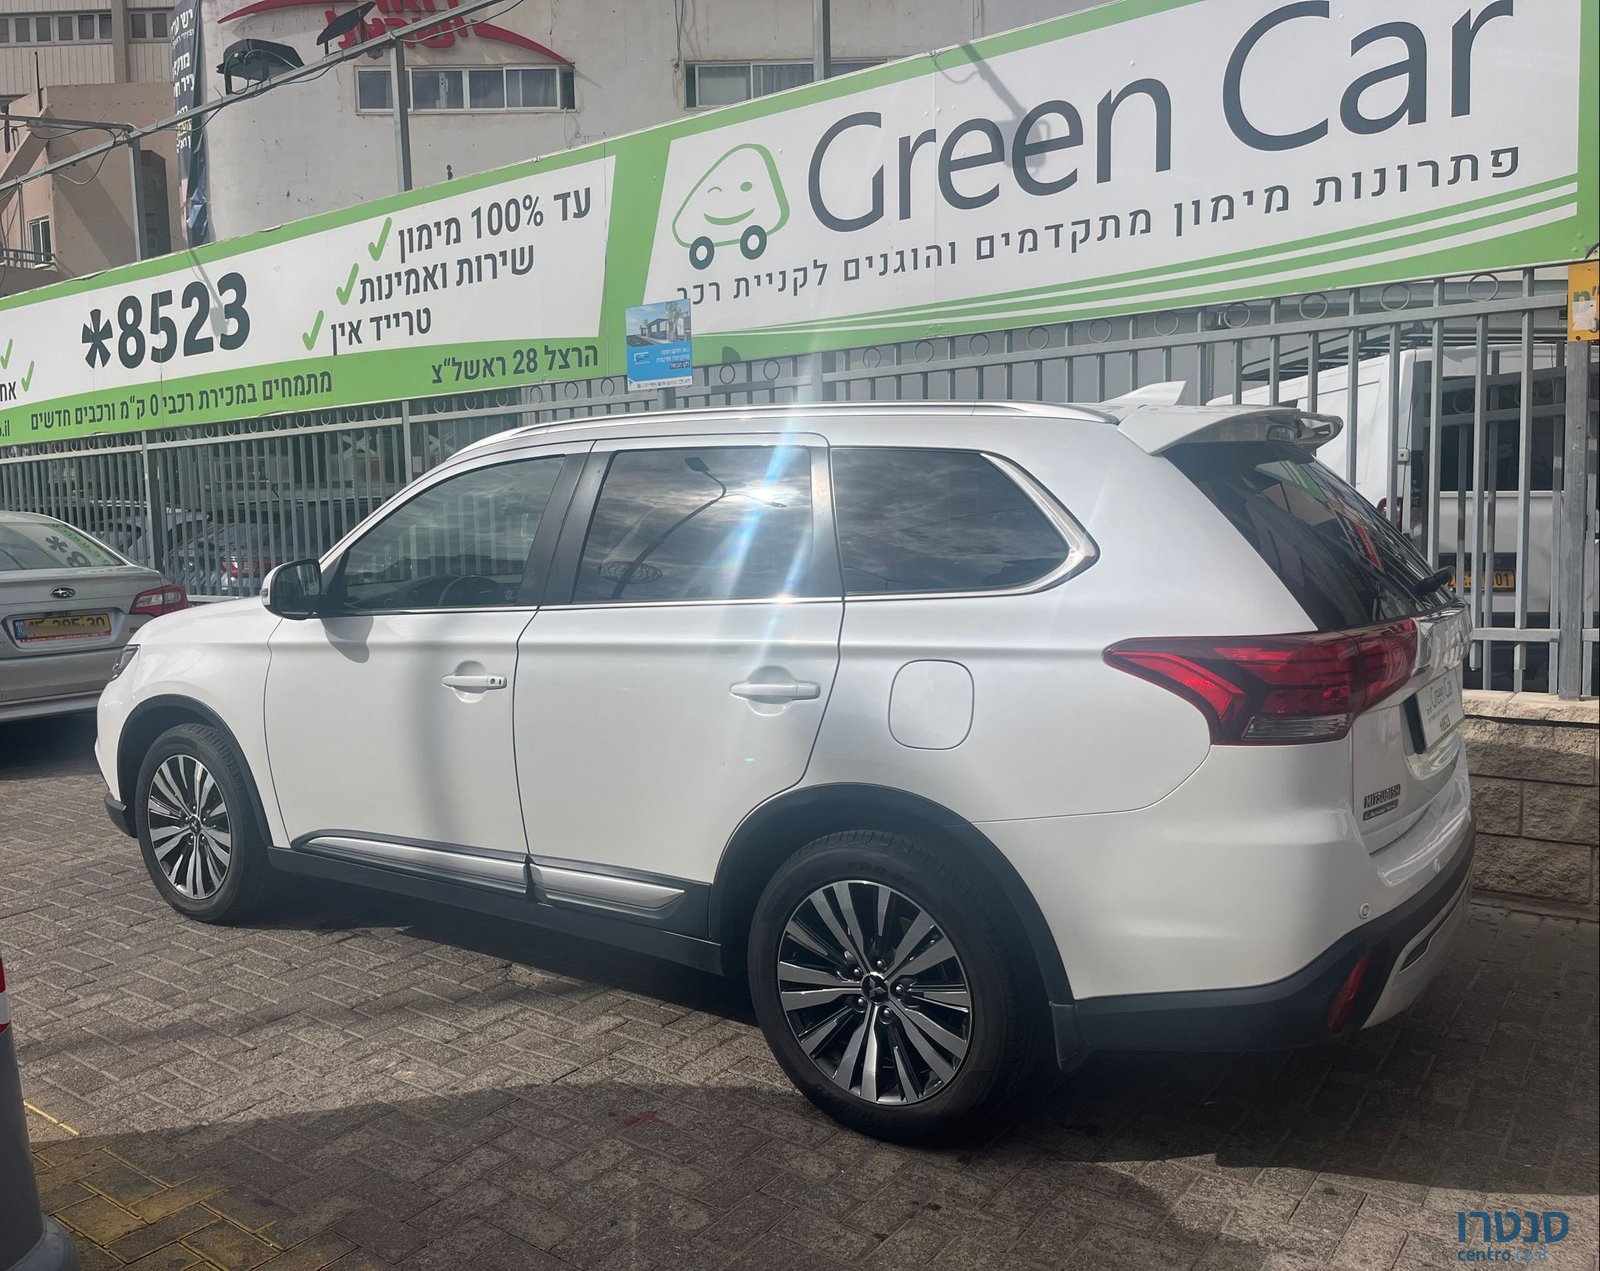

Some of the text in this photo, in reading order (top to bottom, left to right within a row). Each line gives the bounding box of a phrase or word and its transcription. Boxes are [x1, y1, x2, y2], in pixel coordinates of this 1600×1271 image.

[809, 0, 1514, 233] Green Car
[1313, 146, 1520, 207] פתרונות
[398, 187, 591, 264] עד 100% מימון
[1174, 184, 1290, 237] מימון
[976, 208, 1151, 261] מתקדמים
[359, 244, 534, 305] שירות ואמינות
[733, 259, 829, 298] לקניית
[843, 241, 957, 282] והוגנים
[330, 307, 432, 356] טרייד אין
[512, 347, 538, 375] 28
[544, 345, 599, 371] הרצל
[150, 393, 159, 417] 0
[162, 392, 195, 415] רכבי
[198, 383, 258, 411] במכירת
[262, 370, 332, 401] מתמחים
[31, 408, 71, 430] חדשים
[75, 402, 116, 425] ורכבים
